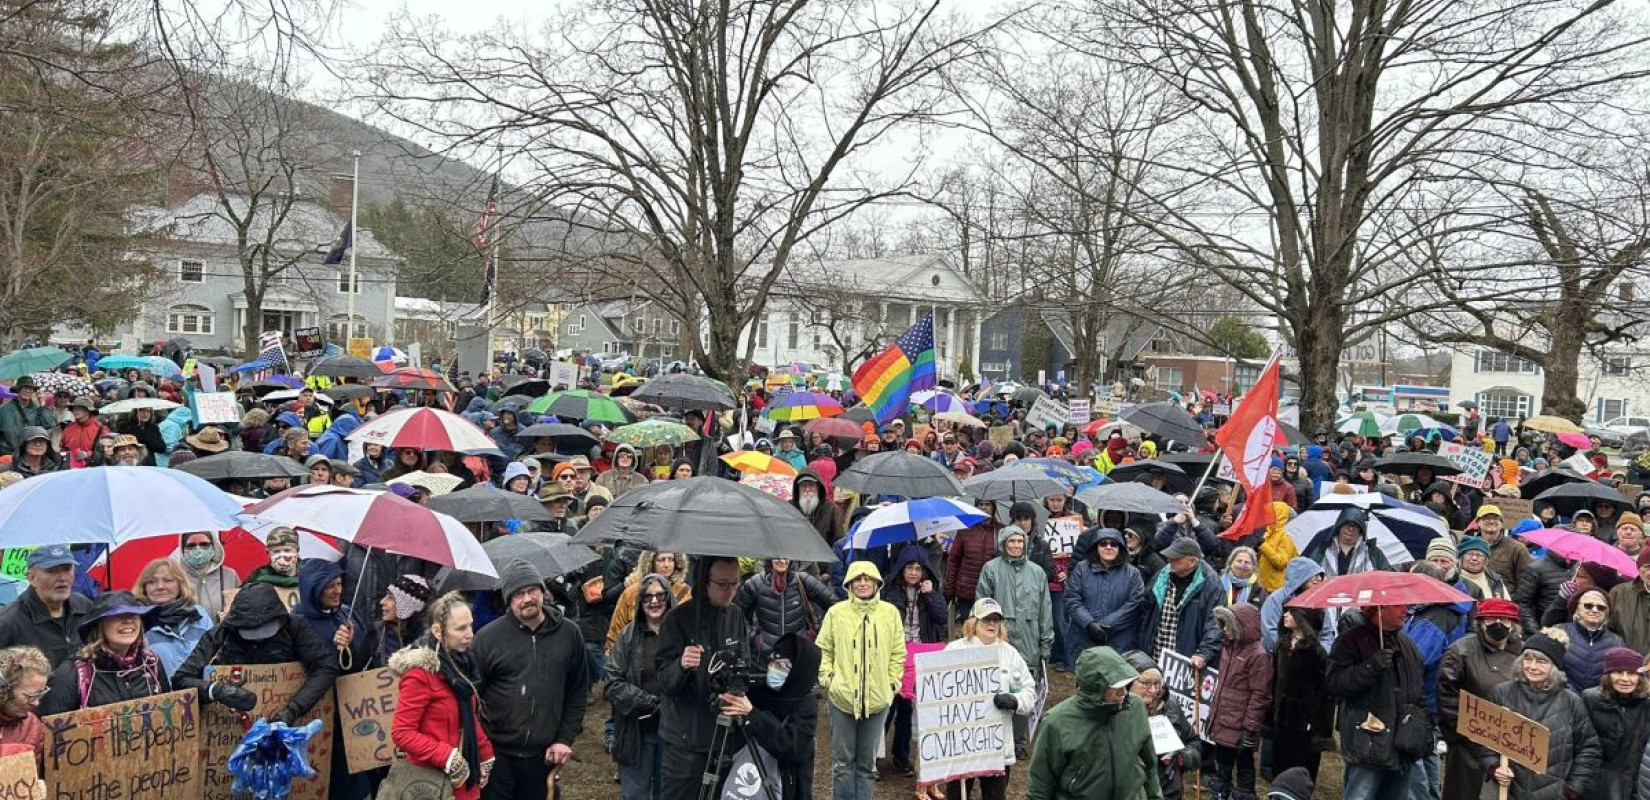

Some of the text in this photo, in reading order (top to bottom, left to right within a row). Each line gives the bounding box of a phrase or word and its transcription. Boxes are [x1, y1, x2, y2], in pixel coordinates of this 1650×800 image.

[1464, 447, 1490, 464] NAZIS
[8, 548, 29, 560] MA
[1049, 536, 1075, 552] CH
[920, 666, 1003, 702] MIGRANTS
[344, 693, 396, 720] WRE
[940, 700, 986, 727] HAVE
[1466, 693, 1508, 730] Hands
[51, 714, 196, 771] For the people
[1468, 718, 1541, 765] Social Security
[86, 771, 122, 800] the
[130, 758, 192, 798] people
